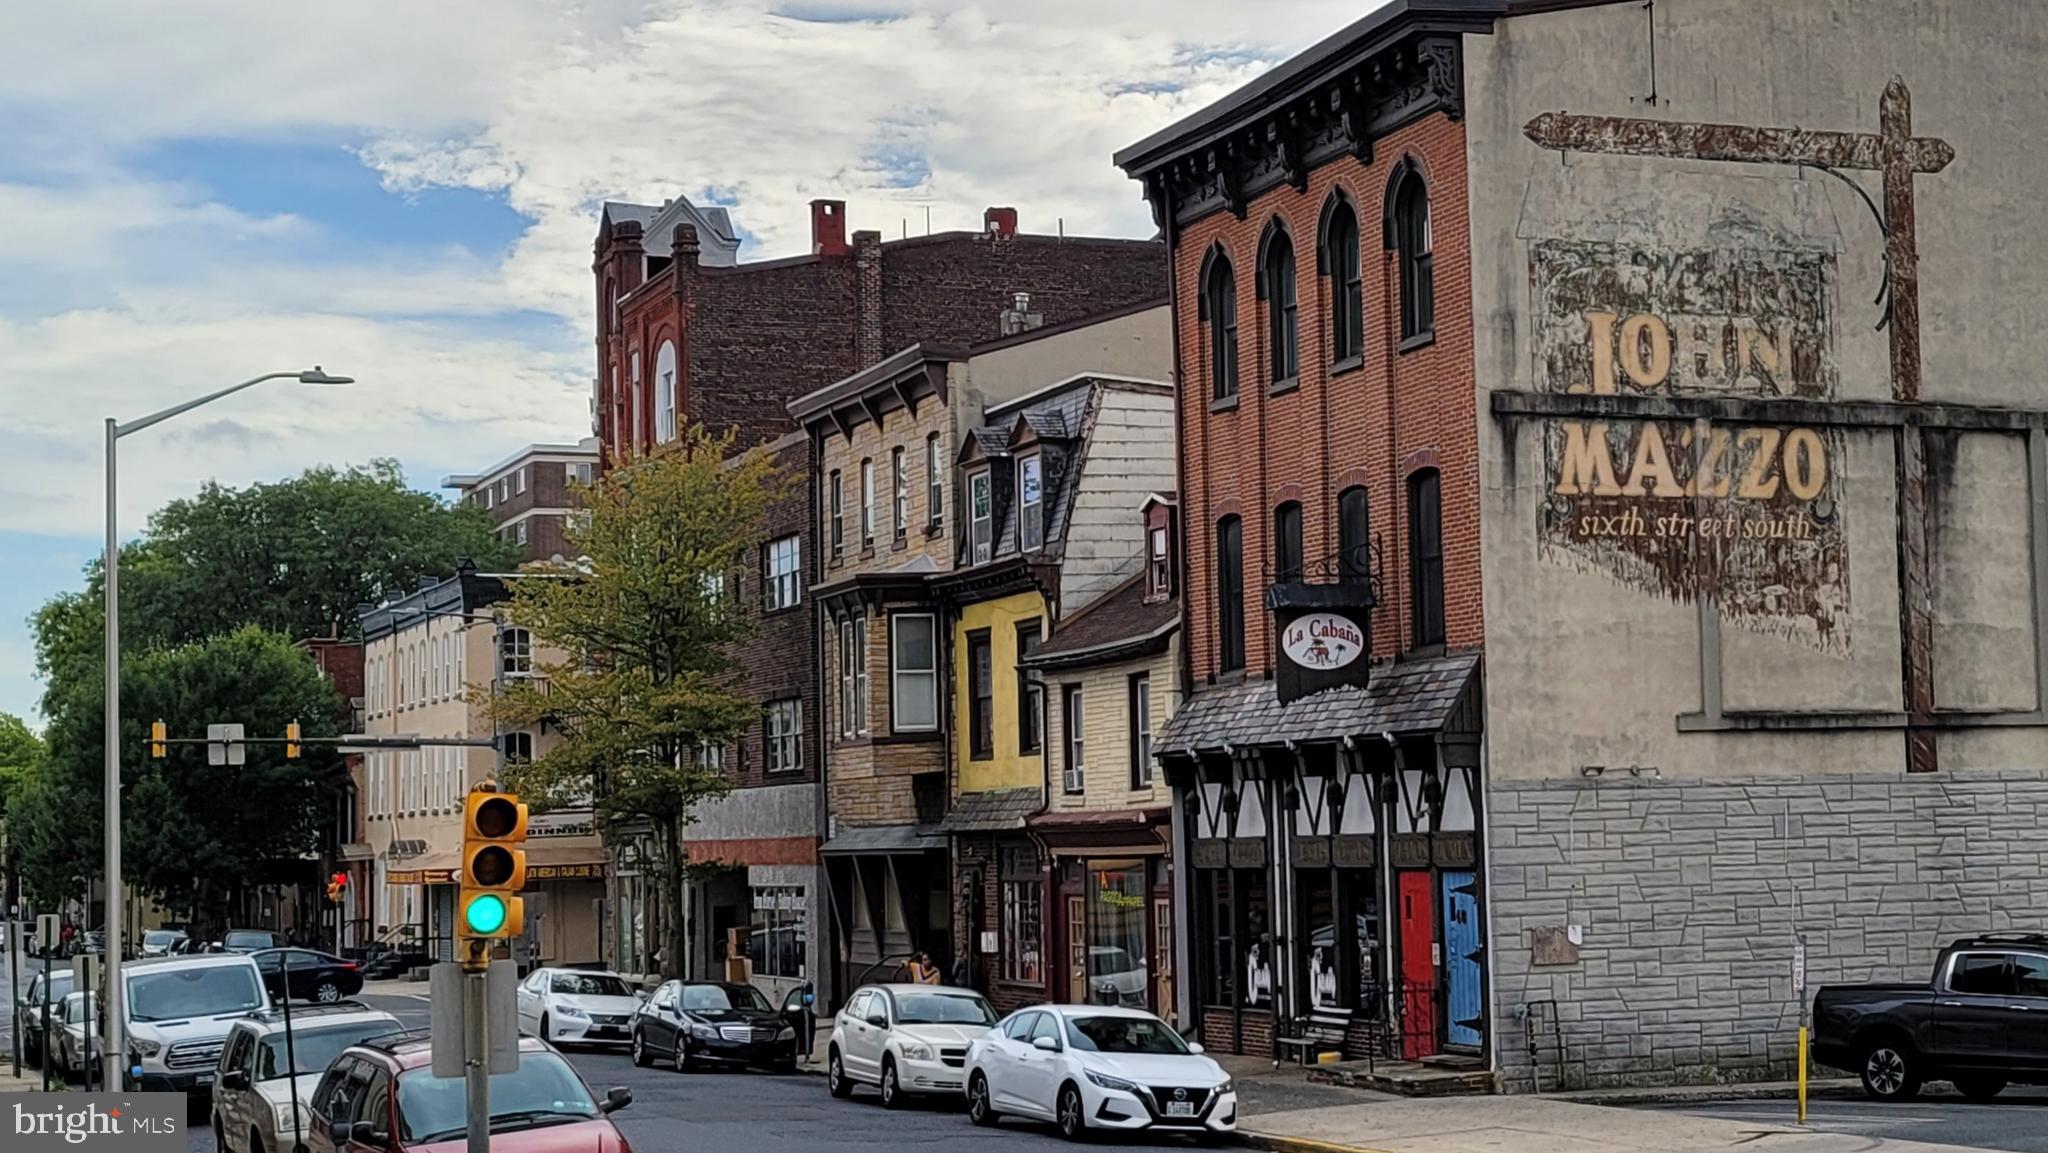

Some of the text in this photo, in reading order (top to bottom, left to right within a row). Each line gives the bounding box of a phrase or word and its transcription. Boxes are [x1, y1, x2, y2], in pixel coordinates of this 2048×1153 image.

[1567, 312, 1795, 396] JOHN
[1555, 421, 1826, 499] MAZZO
[1579, 506, 1647, 537] sixth
[1741, 511, 1812, 541] south
[1288, 619, 1360, 648] La Cabaña
